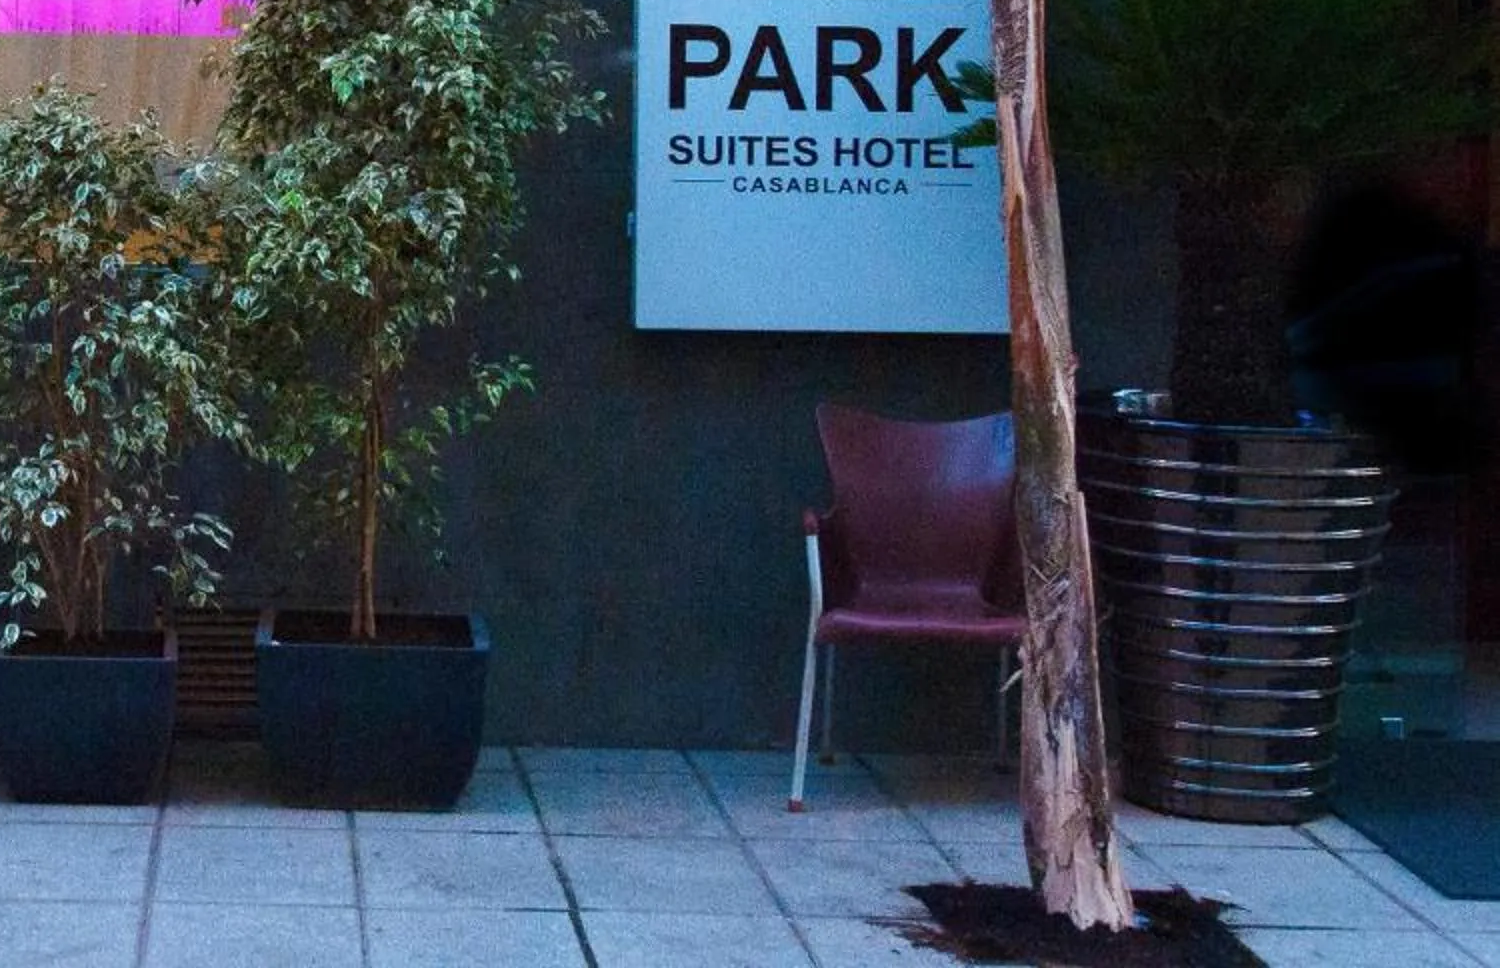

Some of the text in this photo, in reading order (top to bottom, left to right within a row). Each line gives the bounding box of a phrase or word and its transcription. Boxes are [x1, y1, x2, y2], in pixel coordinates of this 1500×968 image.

[668, 23, 969, 113] PARK
[668, 134, 975, 170] SUITES HOTEL
[732, 176, 910, 196] CASABLANCA
